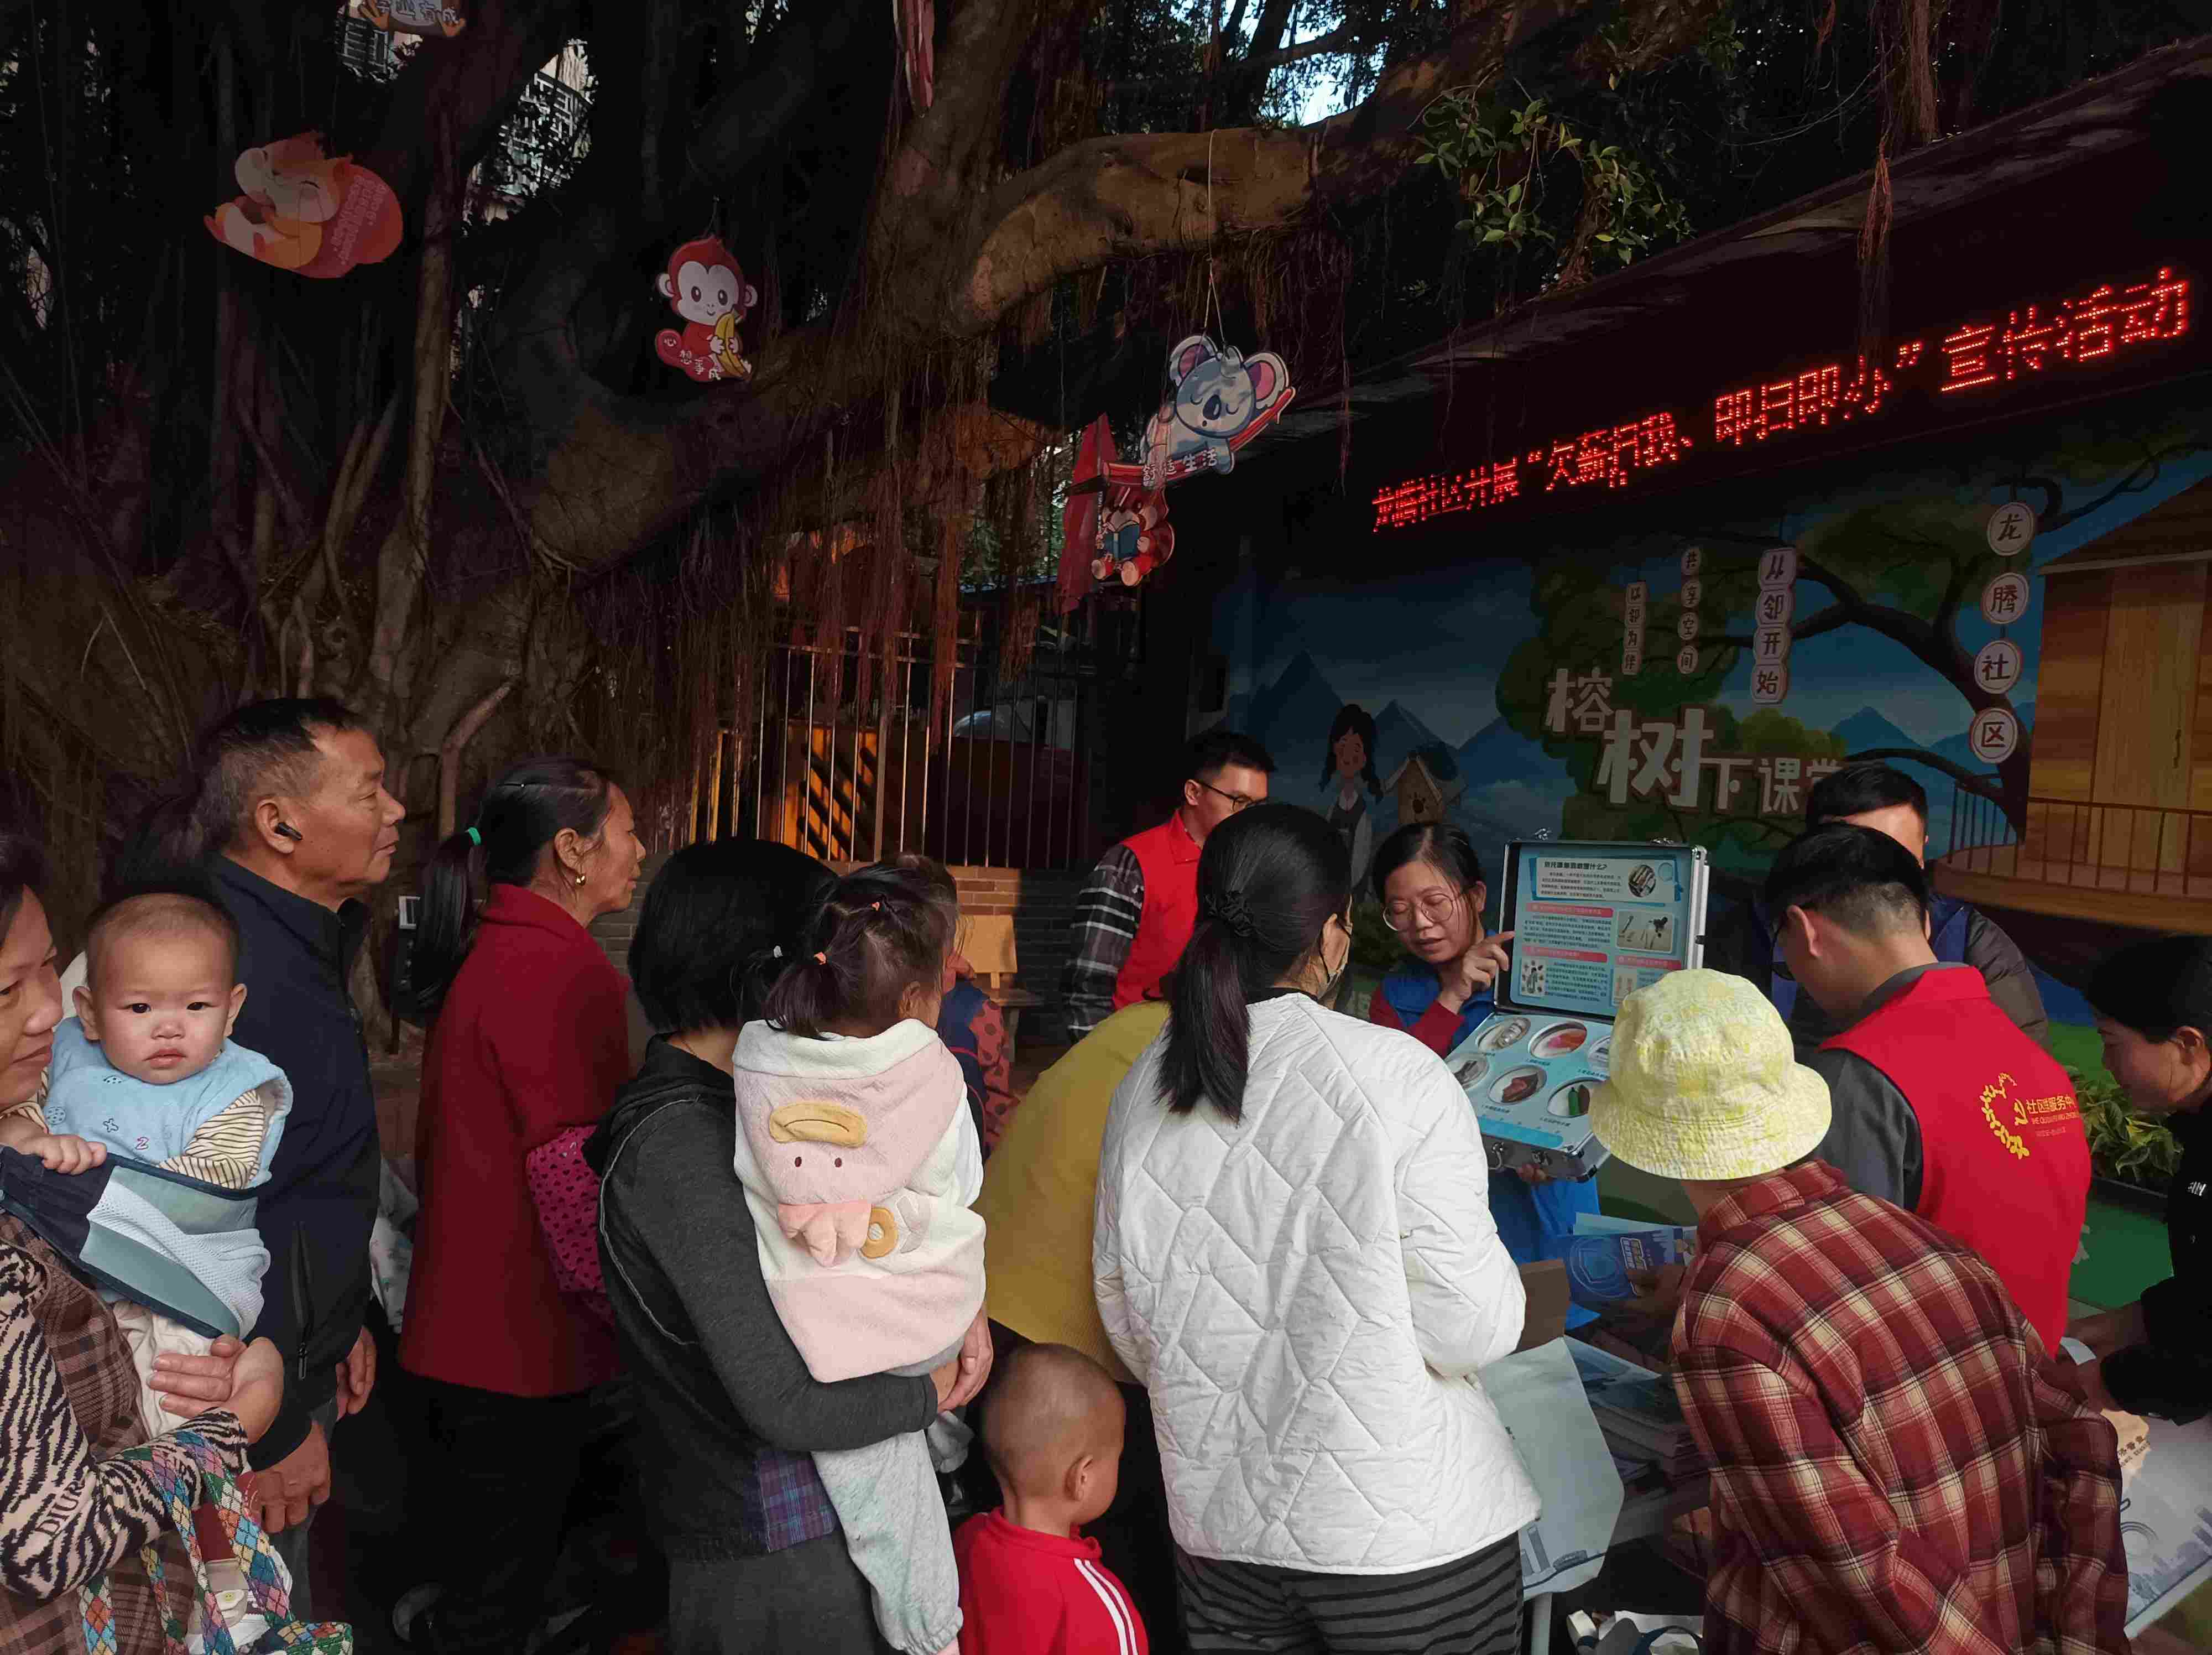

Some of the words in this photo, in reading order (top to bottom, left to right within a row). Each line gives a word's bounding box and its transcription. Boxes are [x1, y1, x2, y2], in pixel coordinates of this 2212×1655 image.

[1679, 551, 1697, 668] 共享空间
[1757, 555, 1785, 695] 从邻开始
[1981, 514, 2023, 748] 龙腾社区
